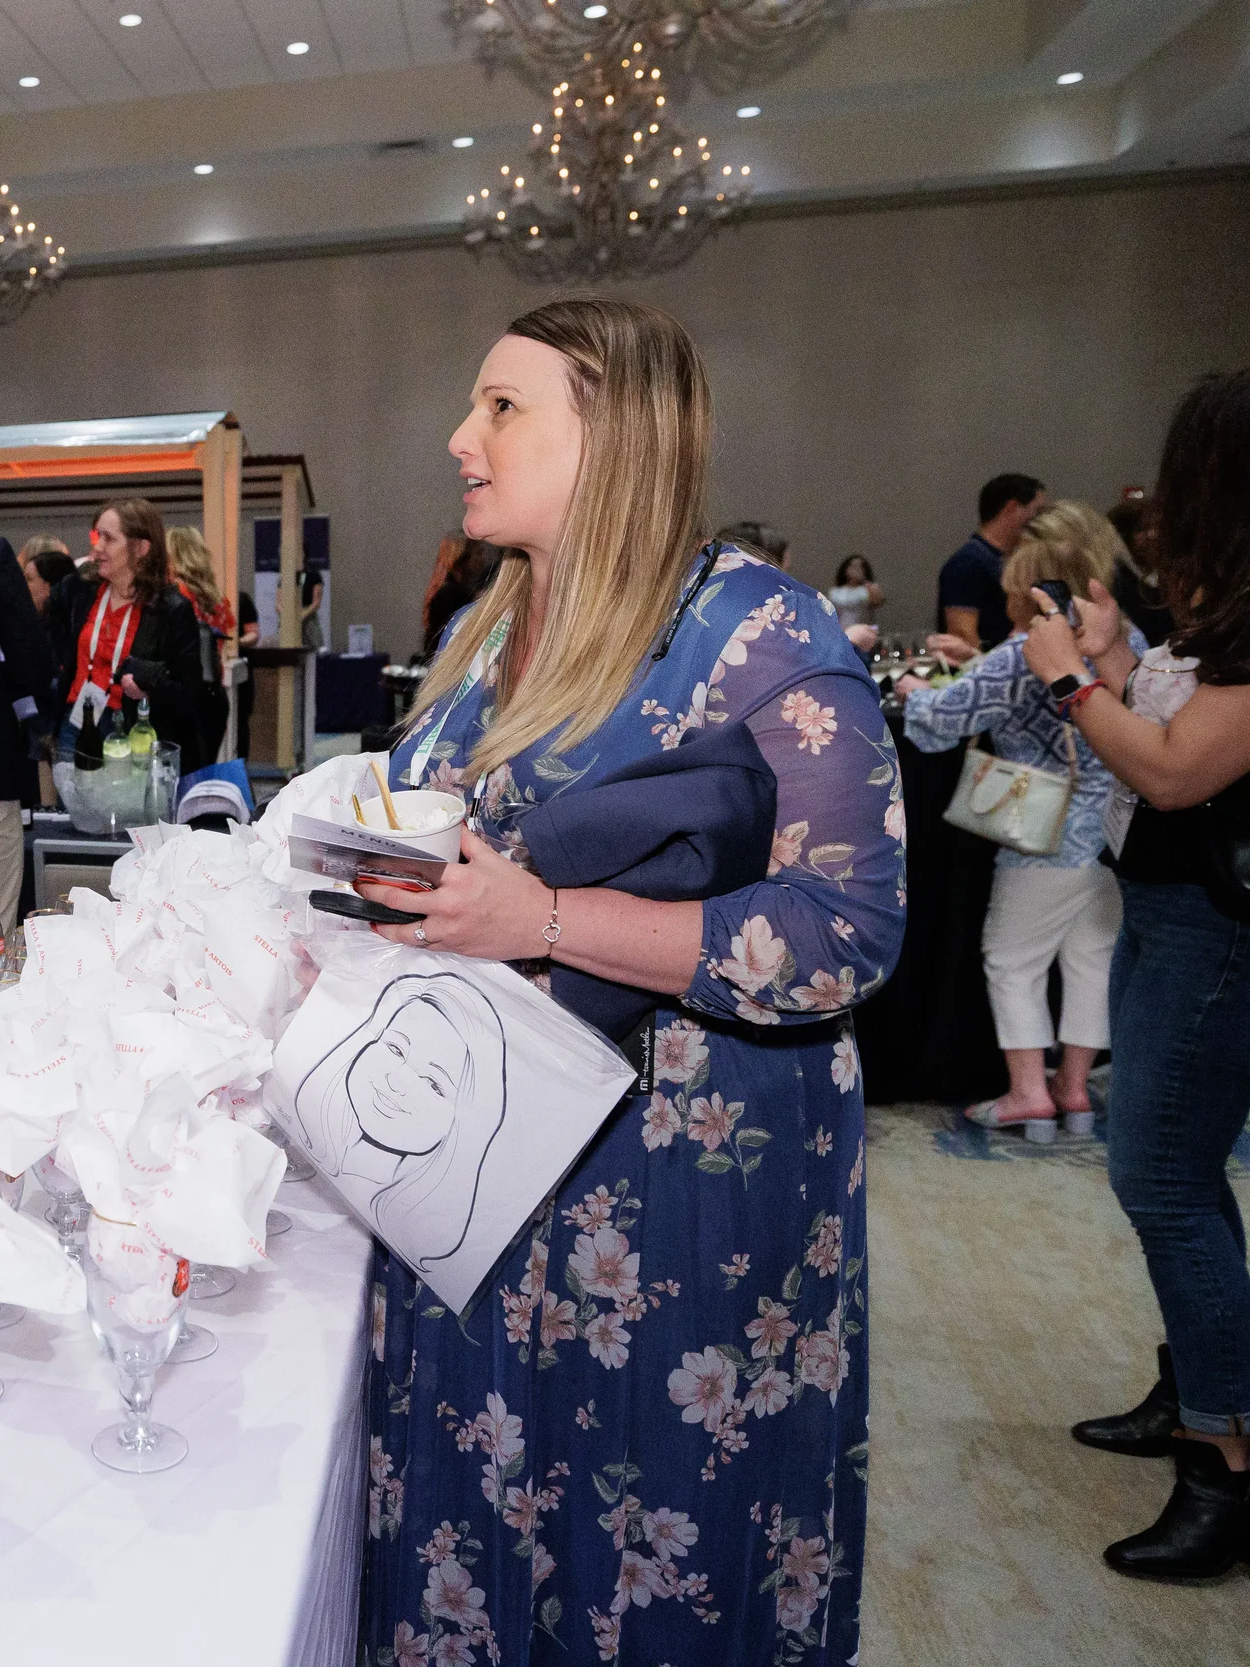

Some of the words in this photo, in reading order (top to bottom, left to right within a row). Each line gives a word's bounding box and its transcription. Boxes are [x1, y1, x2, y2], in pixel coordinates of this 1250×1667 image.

[341, 829, 398, 848] MENU
[253, 934, 278, 959] STELLA
[209, 952, 234, 977] ARTOIS
[232, 1097, 246, 1106] OIS
